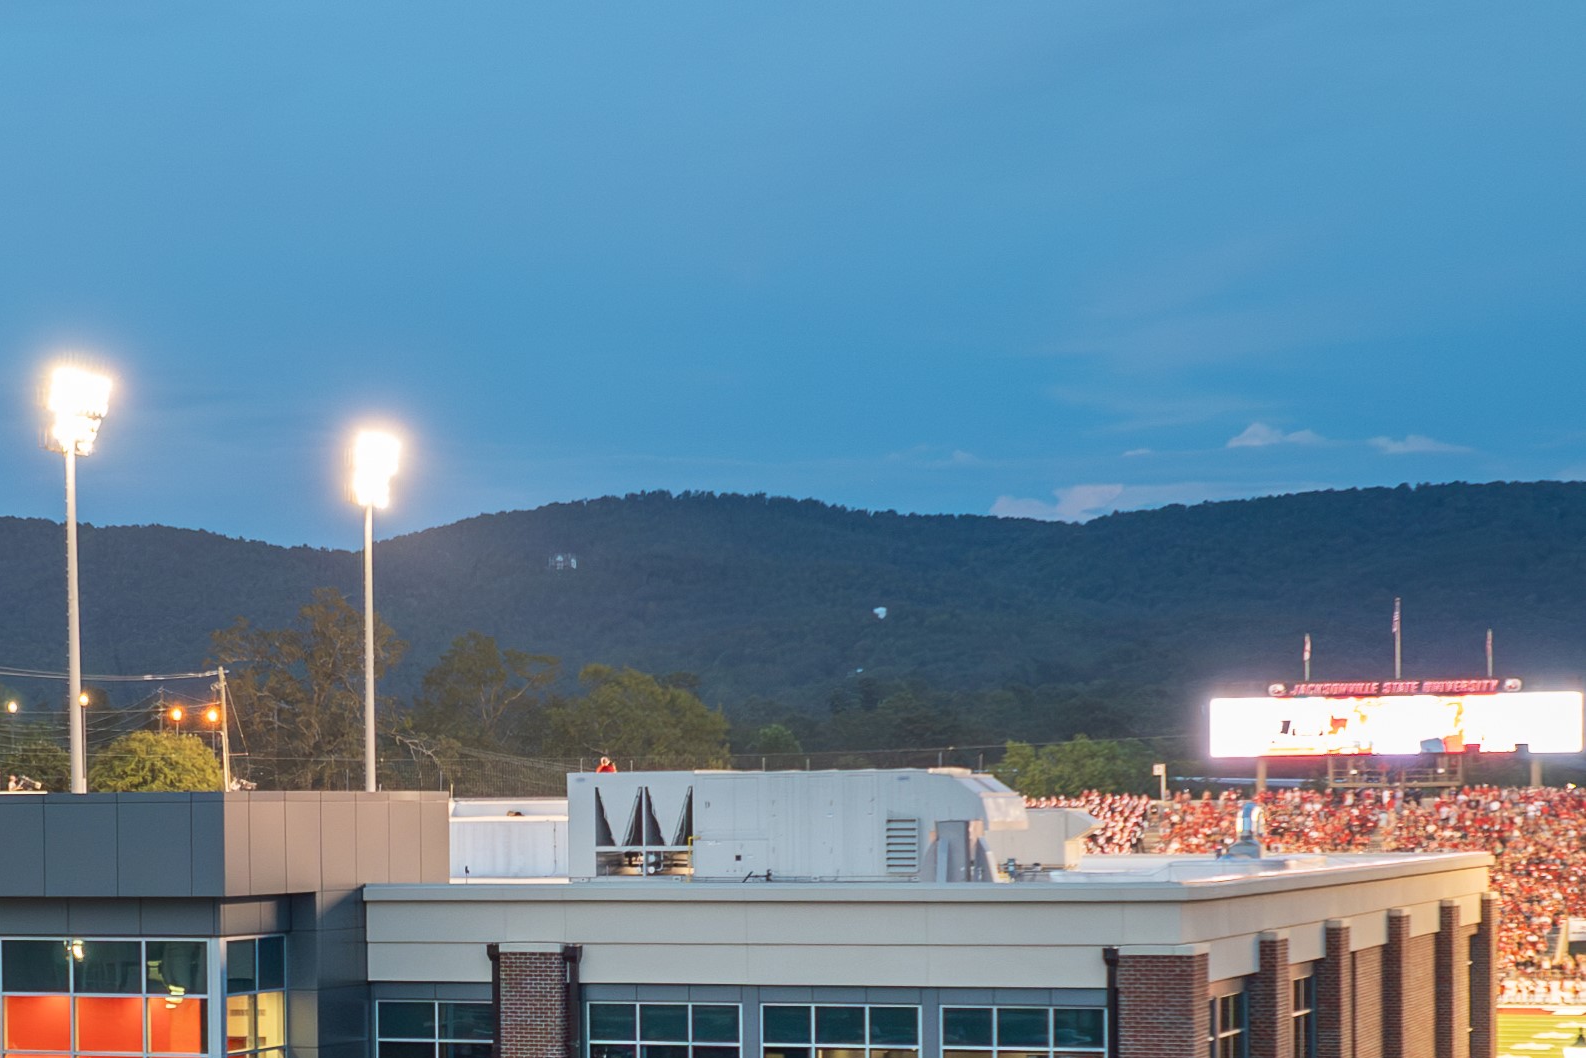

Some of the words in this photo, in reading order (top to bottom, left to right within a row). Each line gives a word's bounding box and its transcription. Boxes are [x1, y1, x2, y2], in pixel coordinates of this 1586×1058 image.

[1289, 682, 1378, 696] JACKSONVILLE
[1382, 681, 1419, 694] STATE
[1421, 679, 1499, 693] UNIVERSITY
